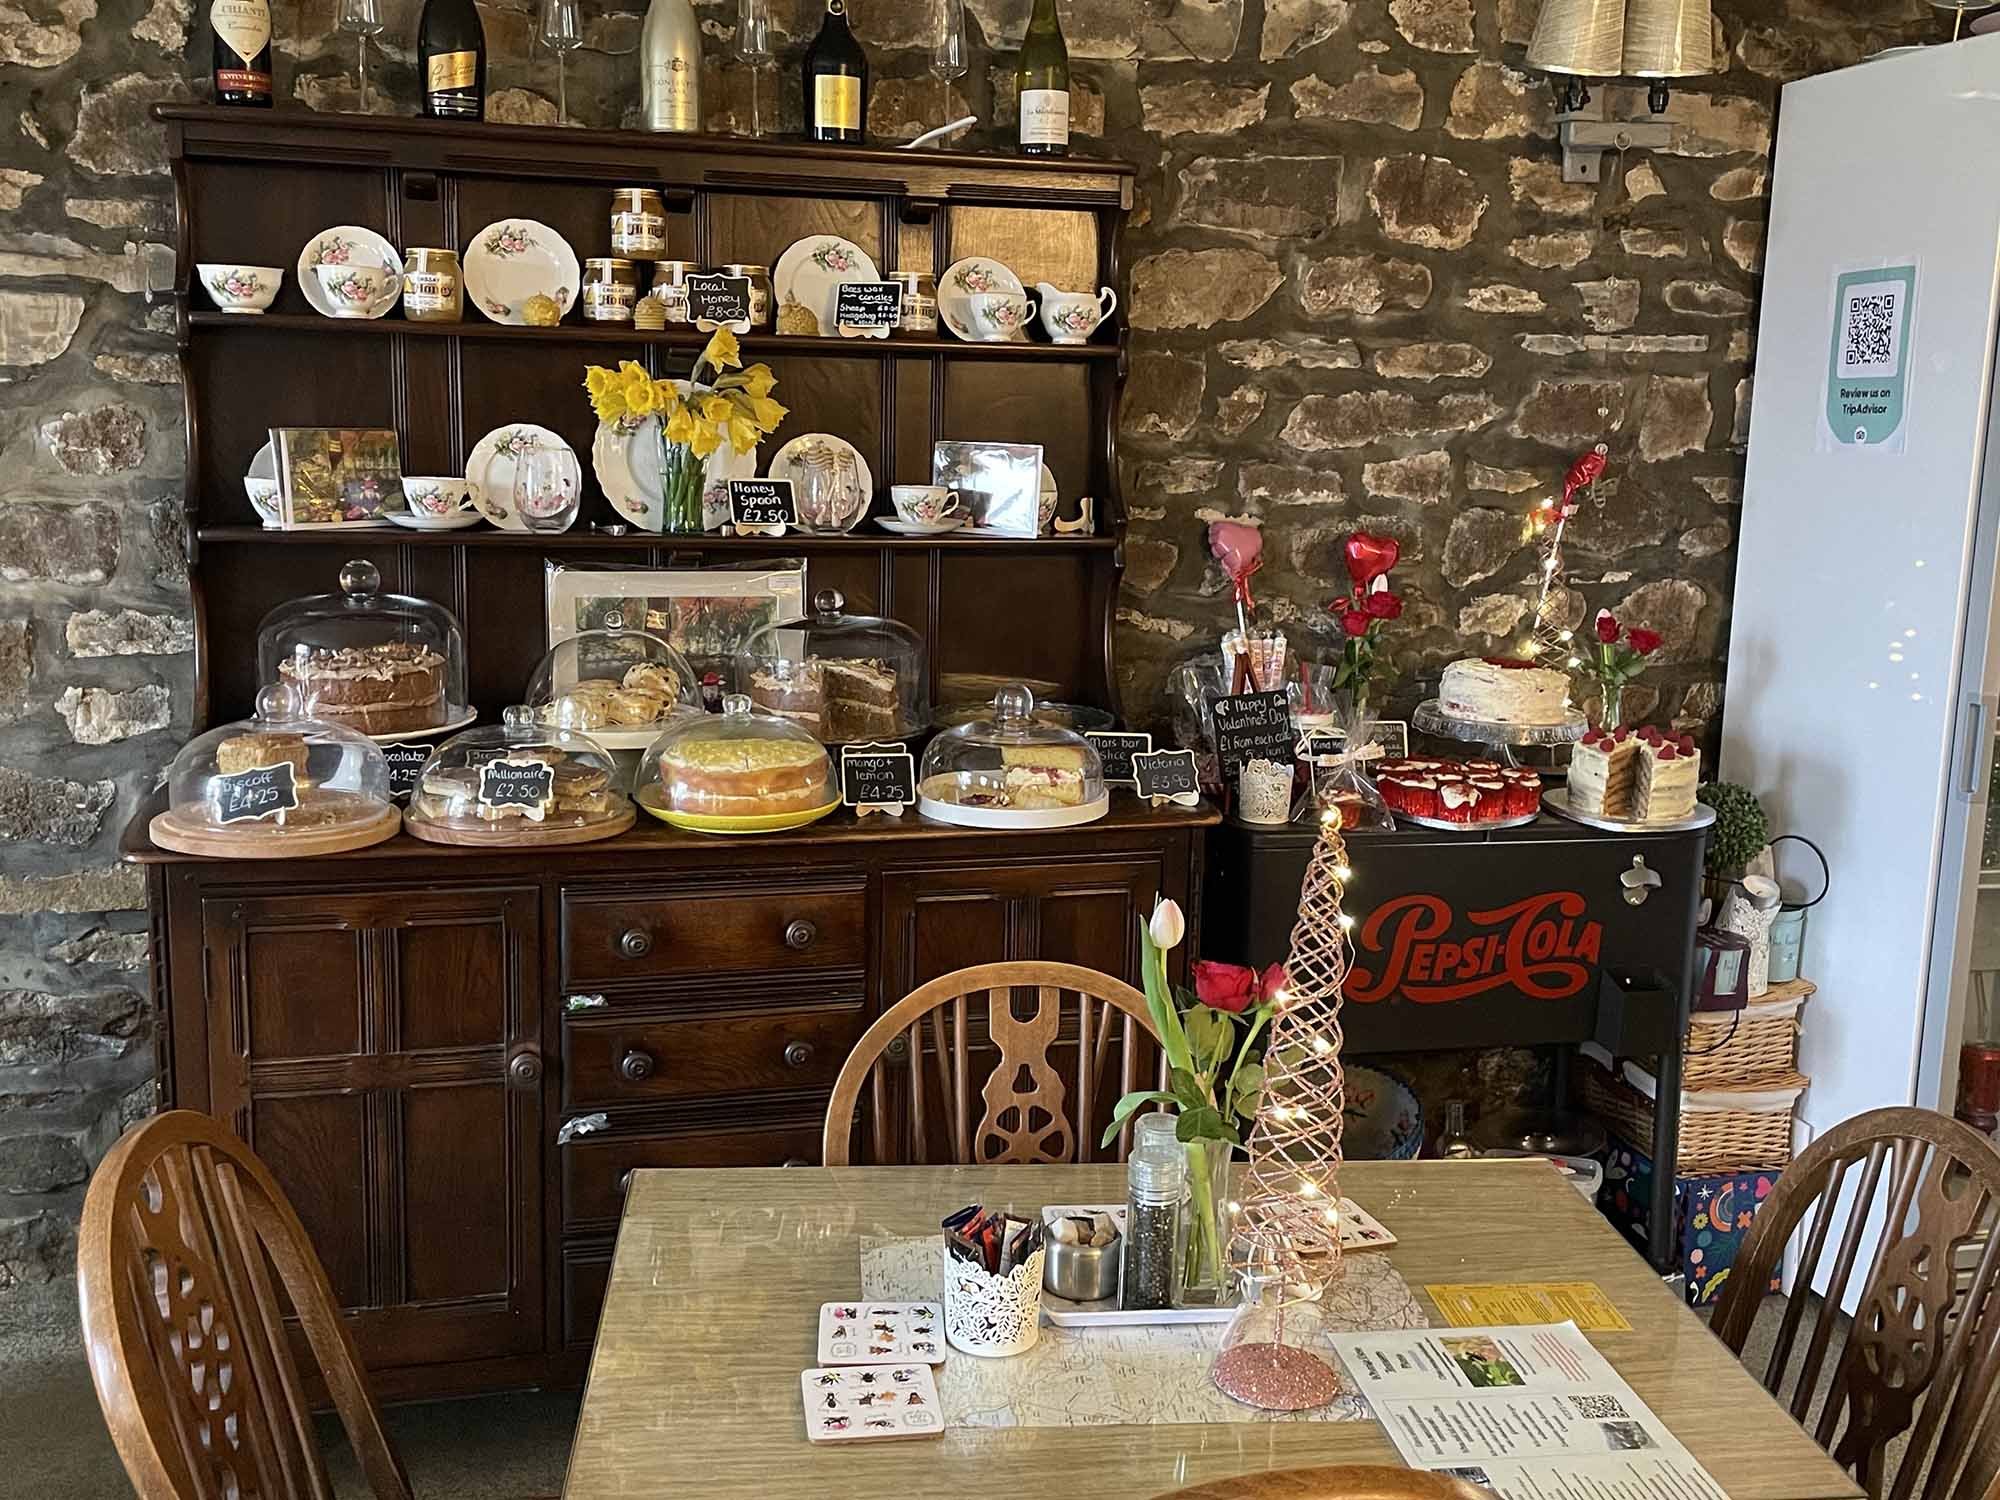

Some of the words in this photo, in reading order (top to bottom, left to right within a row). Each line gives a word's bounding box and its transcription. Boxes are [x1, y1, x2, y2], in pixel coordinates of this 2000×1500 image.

[693, 279, 728, 291] Local
[700, 295, 740, 309] Honey
[858, 294, 893, 302] candles
[1840, 387, 1869, 400] Review
[1869, 389, 1879, 398] us
[1880, 388, 1891, 398] on
[1842, 403, 1888, 416] TripAdvisor
[734, 482, 775, 496] Honey
[740, 495, 782, 508] Spoon
[742, 508, 789, 522] £2.50
[1235, 698, 1267, 713] Happy
[1269, 707, 1289, 735] Day
[846, 758, 885, 772] mango
[1139, 757, 1185, 770] Victoria
[487, 770, 545, 780] Millionaire
[855, 770, 894, 781] lemon
[223, 771, 274, 793] Biscoff
[229, 786, 279, 813] £4.25
